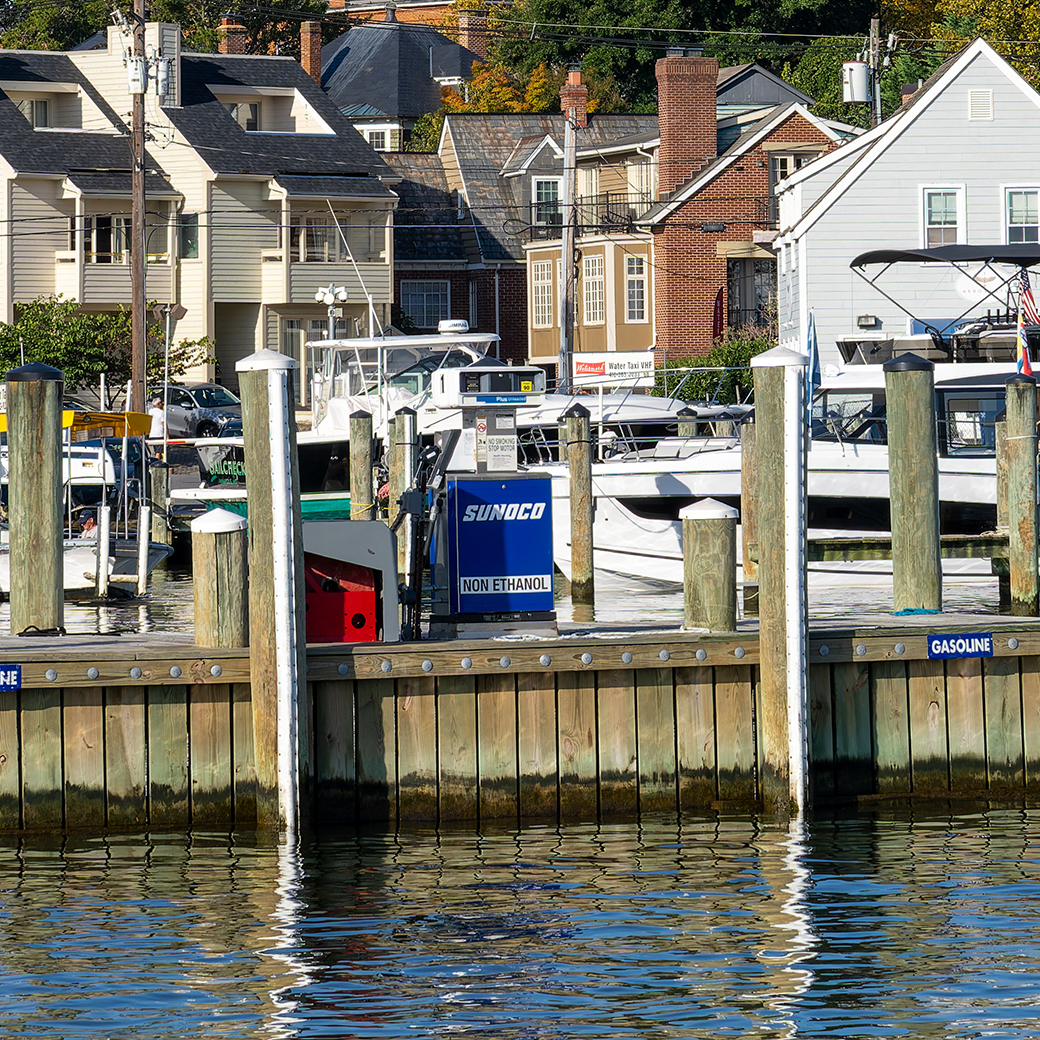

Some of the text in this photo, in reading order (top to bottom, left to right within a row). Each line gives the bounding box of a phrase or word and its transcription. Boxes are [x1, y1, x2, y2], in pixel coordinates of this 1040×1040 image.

[608, 360, 653, 370] Water Taxi VHF
[488, 444, 500, 452] STOP
[500, 444, 515, 452] MOTOR
[462, 502, 546, 522] SUNOCO
[463, 577, 549, 592] NON ETHANOL
[931, 638, 991, 654] GASOLINE
